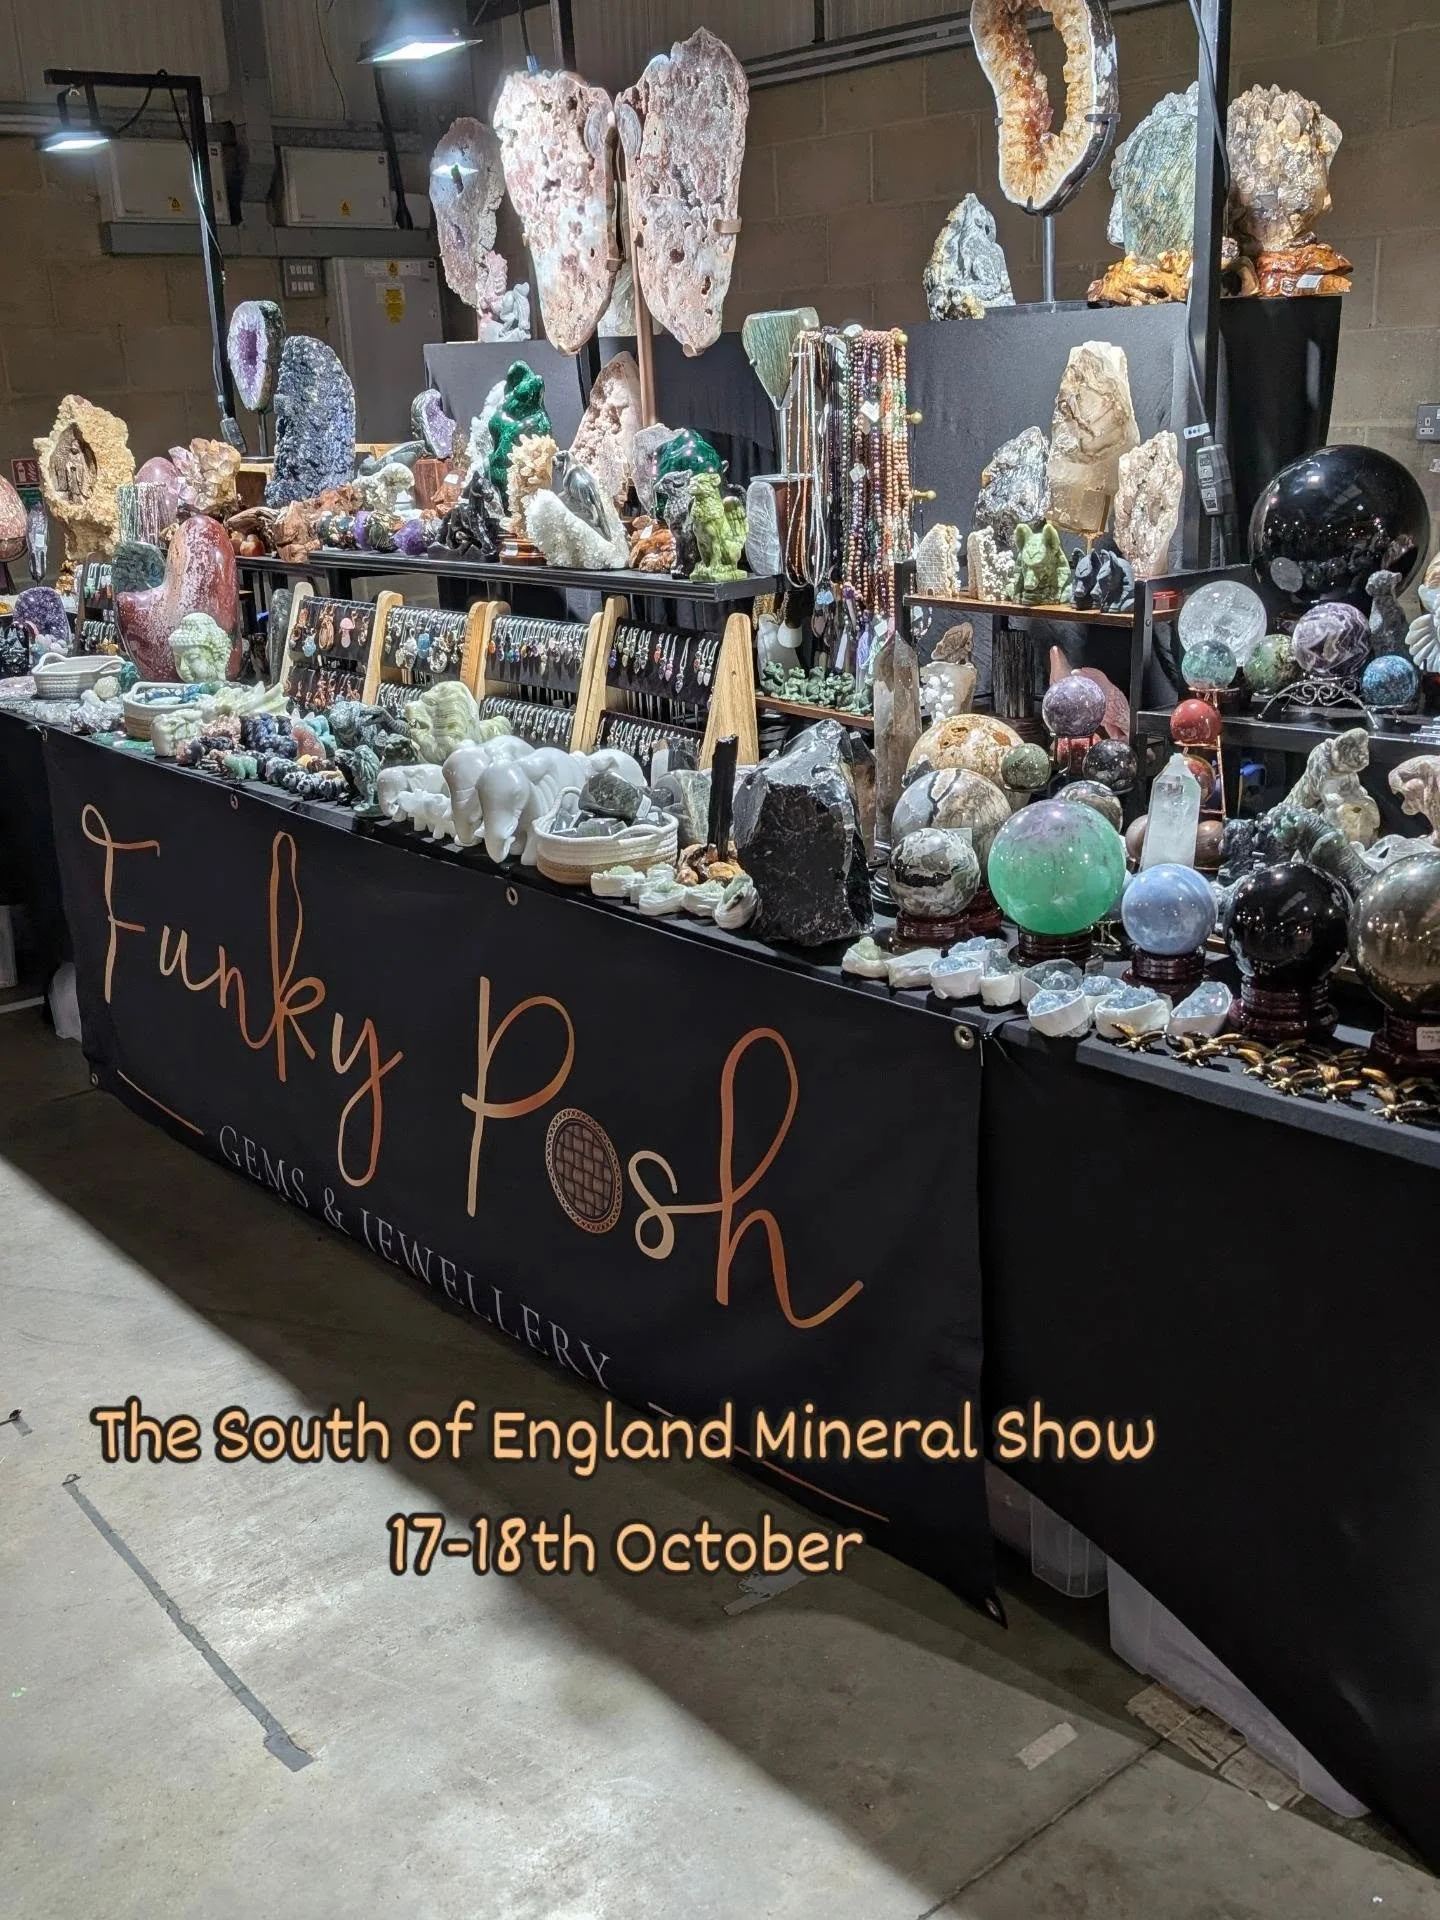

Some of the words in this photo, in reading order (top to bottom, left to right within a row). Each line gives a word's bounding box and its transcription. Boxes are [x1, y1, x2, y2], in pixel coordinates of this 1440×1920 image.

[82, 803, 403, 1187] Funky
[219, 1125, 309, 1208] GEMS
[323, 1186, 351, 1235] &
[360, 1207, 611, 1391] JEWELLERY
